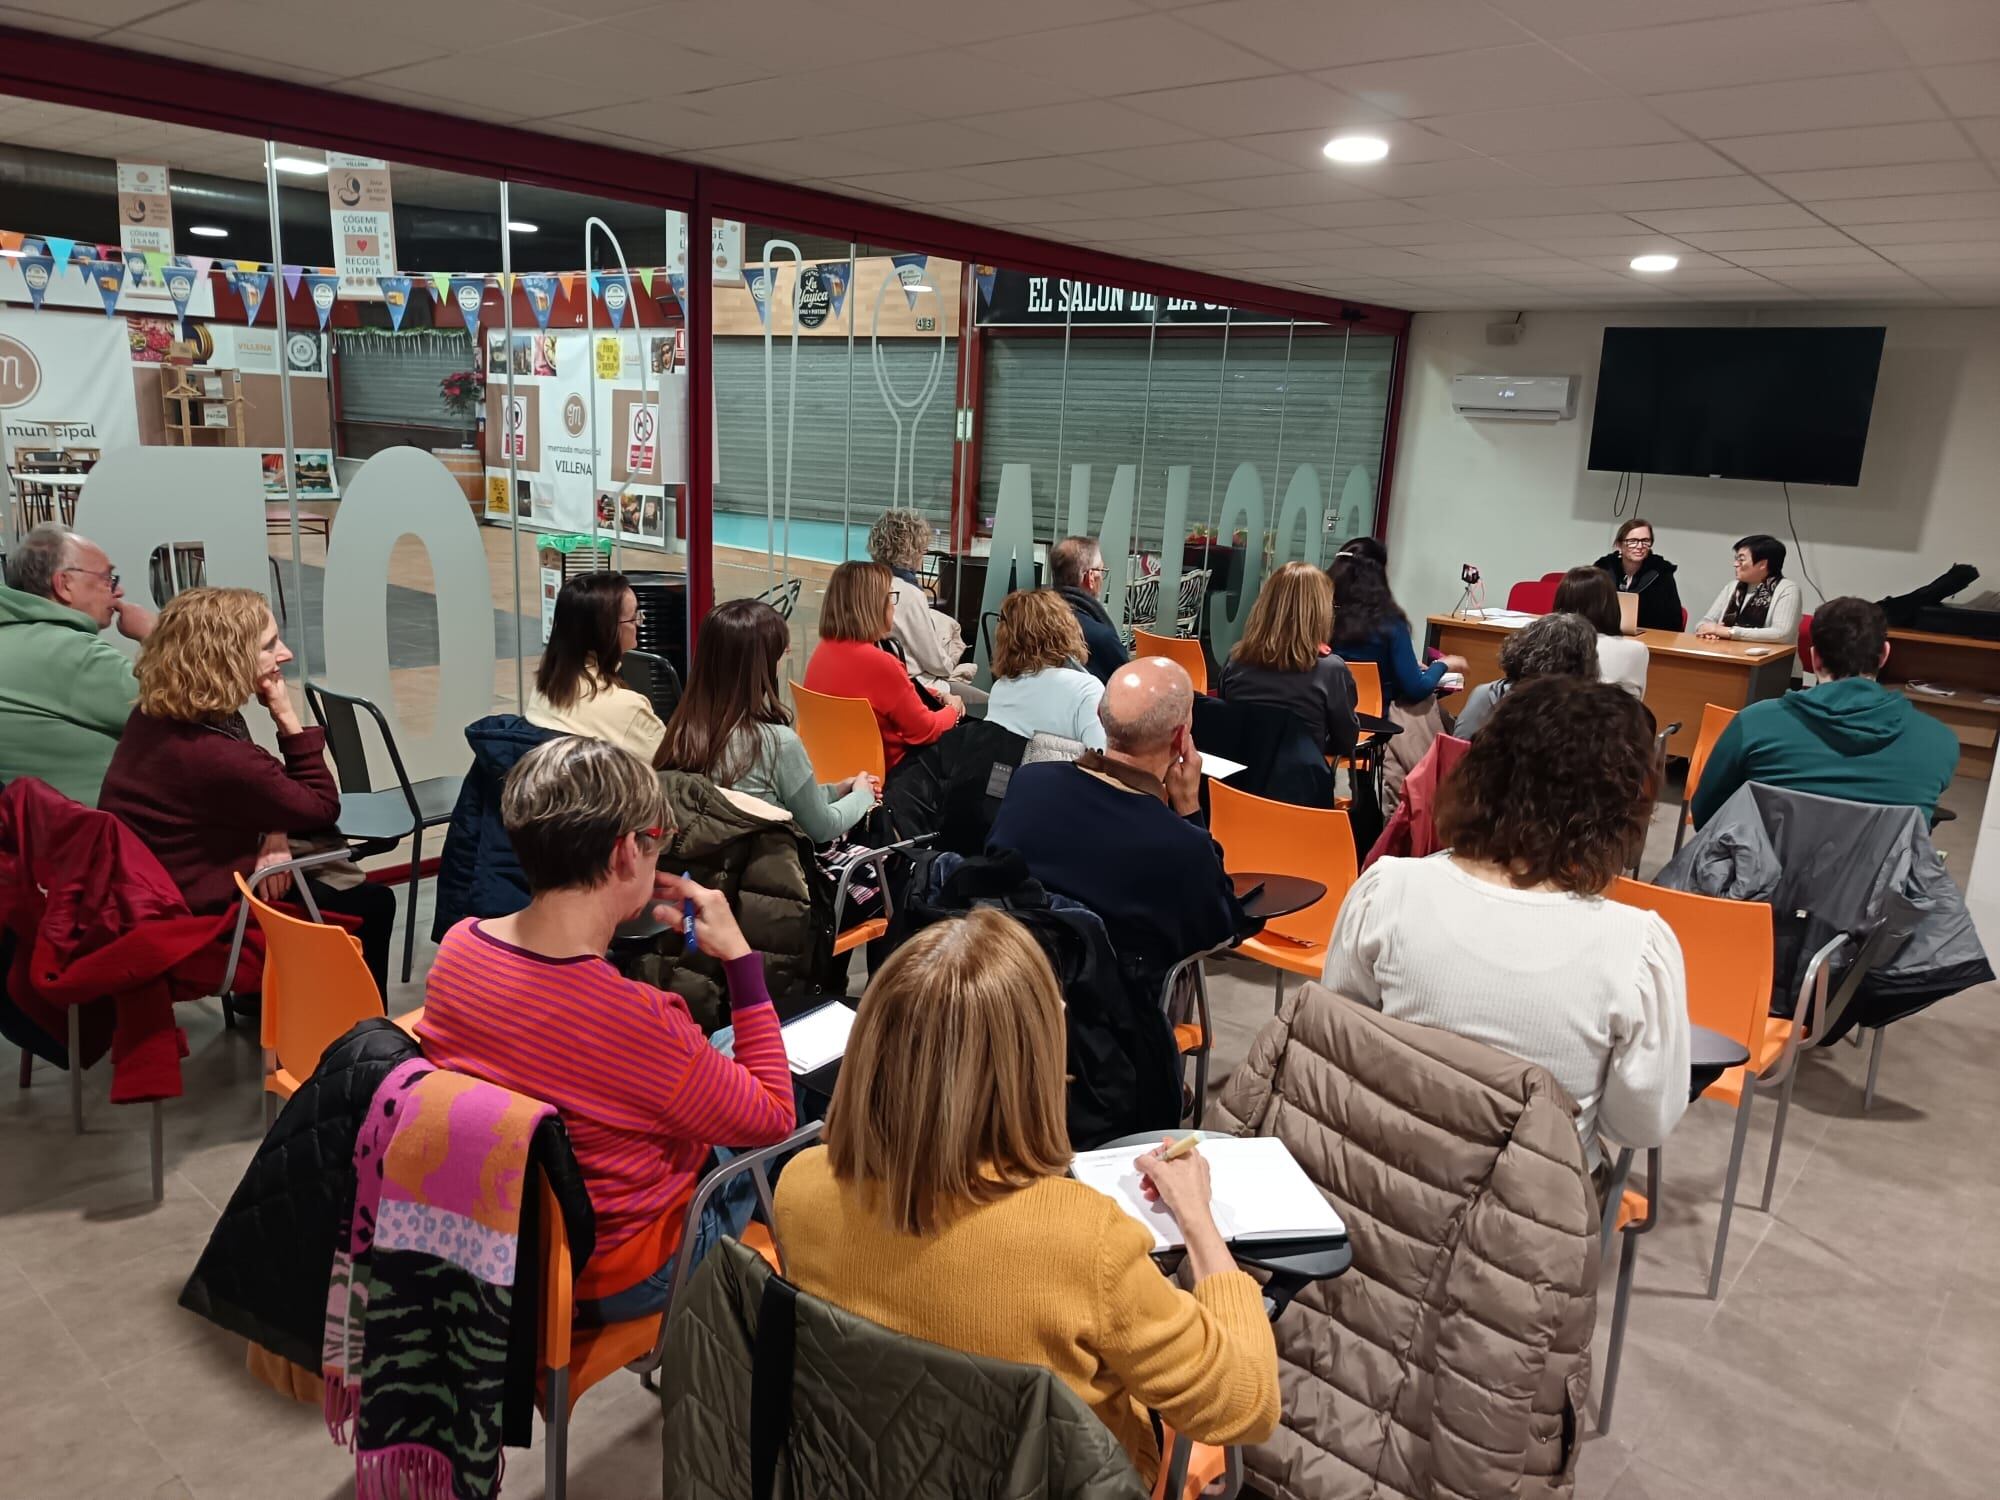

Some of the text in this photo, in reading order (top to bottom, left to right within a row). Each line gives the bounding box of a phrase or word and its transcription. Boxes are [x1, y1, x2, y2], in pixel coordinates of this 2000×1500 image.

[680, 227, 724, 240] RGE
[345, 256, 381, 266] RECOGE
[346, 266, 382, 275] LIMPIA
[805, 276, 818, 292] La
[1027, 277, 1053, 312] EL
[6, 424, 97, 441] muncipal
[555, 460, 593, 476] VILLENA
